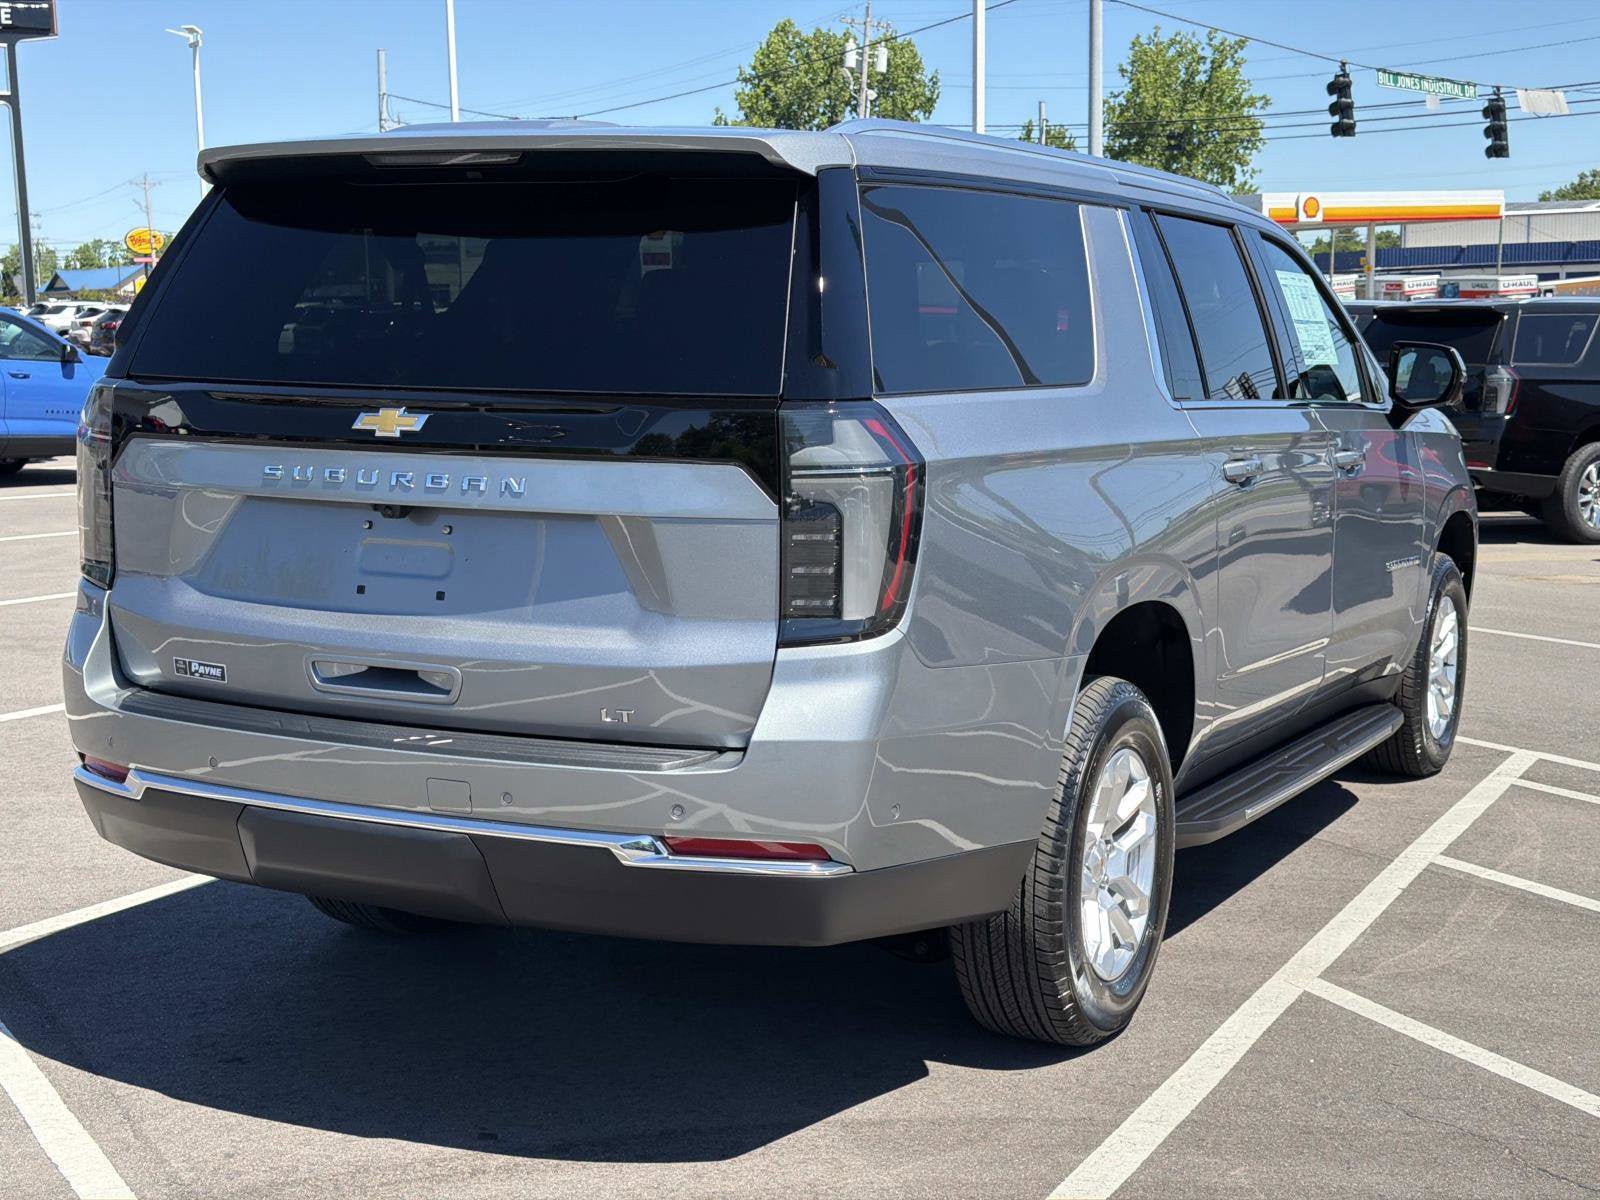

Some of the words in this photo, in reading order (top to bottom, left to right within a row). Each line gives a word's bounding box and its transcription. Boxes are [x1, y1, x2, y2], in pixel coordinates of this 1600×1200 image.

[1378, 71, 1395, 86] BILL
[1396, 75, 1419, 90] JONES
[1420, 79, 1463, 97] INDUSTRIAL
[1464, 85, 1475, 98] DR
[1502, 280, 1534, 288] U-HAUL
[263, 465, 527, 494] SUBURBAN
[600, 708, 635, 723] LT
